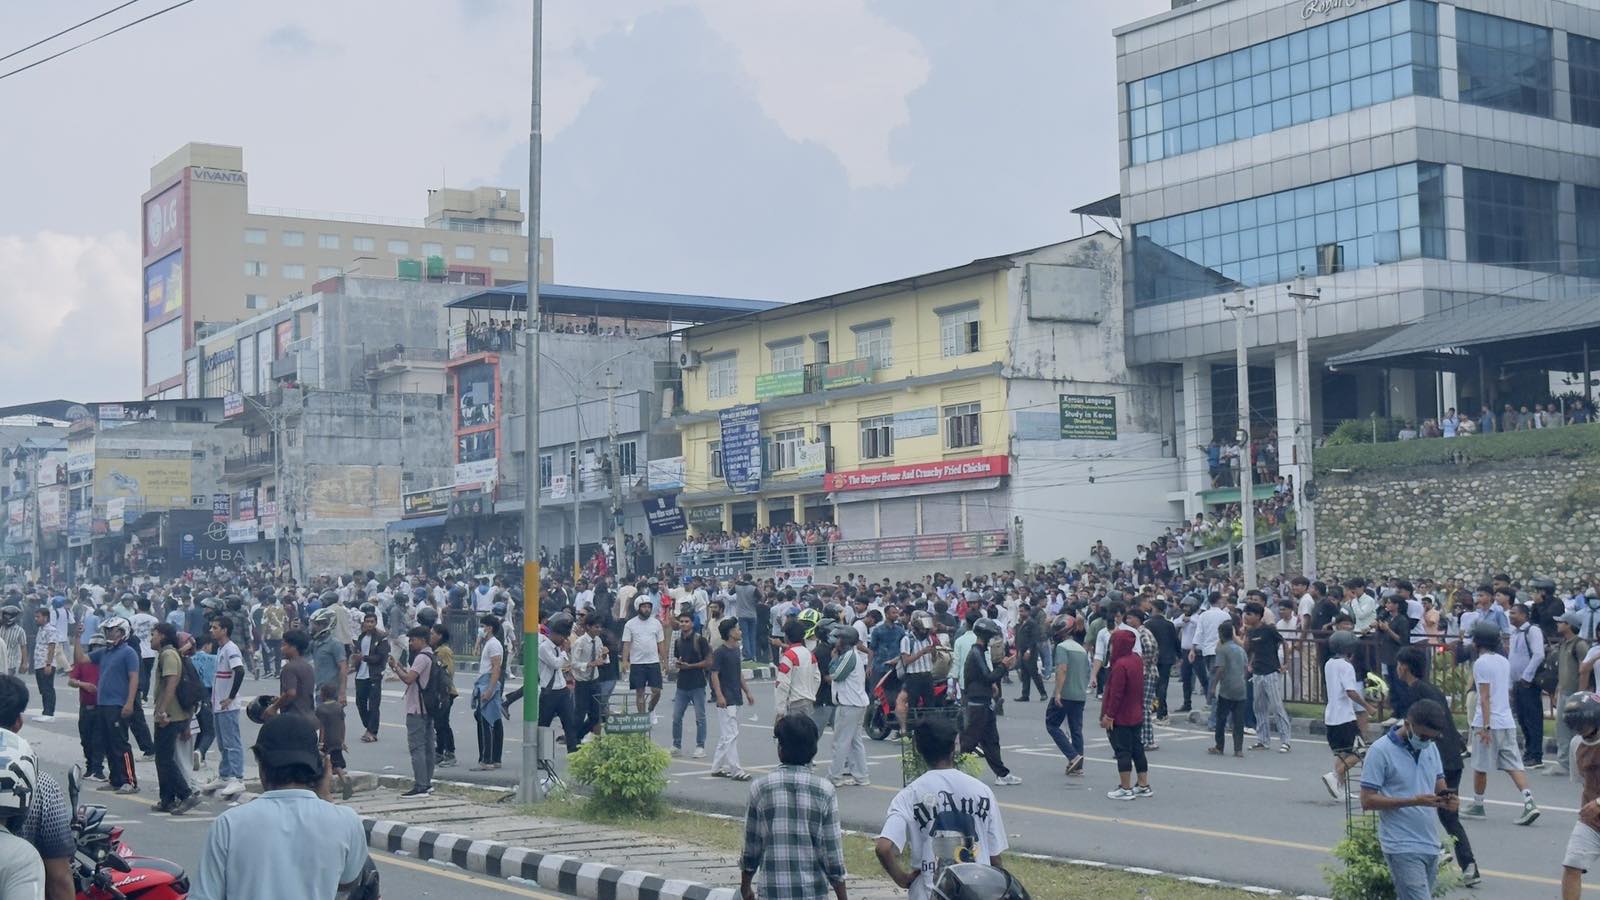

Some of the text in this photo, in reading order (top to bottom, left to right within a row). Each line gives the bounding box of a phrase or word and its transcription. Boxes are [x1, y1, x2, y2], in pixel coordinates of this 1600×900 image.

[194, 170, 245, 182] VIVANTA
[163, 198, 177, 233] LG
[1065, 410, 1083, 419] Study
[848, 462, 991, 486] The Burger House And Crunchy Fried Chicken
[691, 566, 734, 577] KCT Cafe
